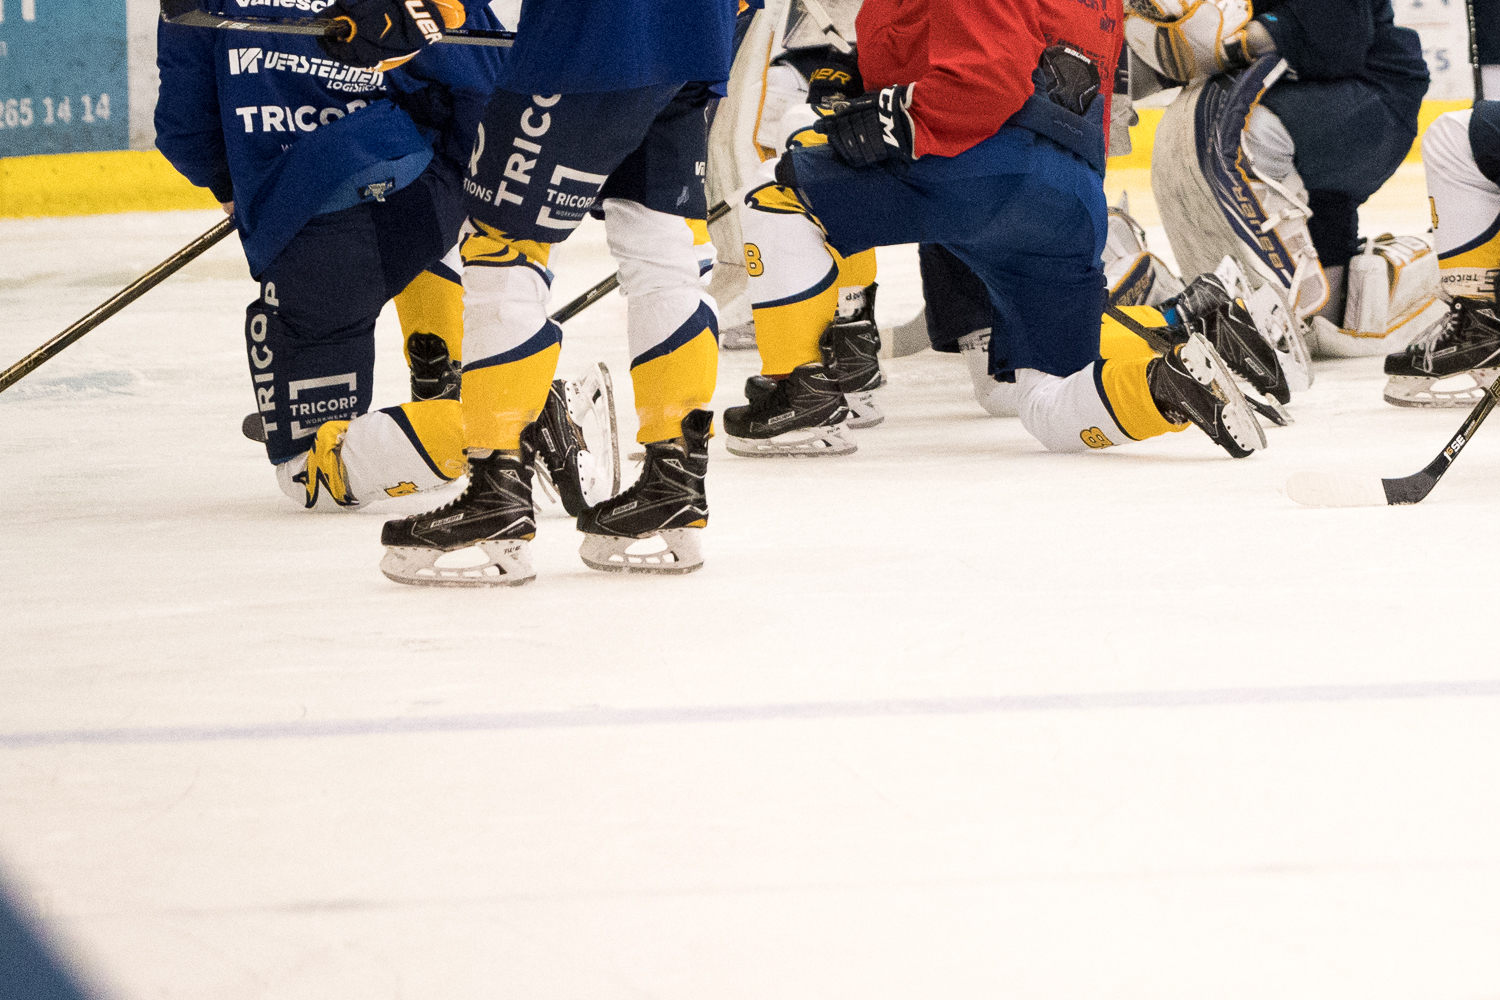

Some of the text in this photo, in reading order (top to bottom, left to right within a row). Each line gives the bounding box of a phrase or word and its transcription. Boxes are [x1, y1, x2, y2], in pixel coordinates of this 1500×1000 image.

[42, 95, 72, 126] 14
[80, 92, 111, 123] 14
[289, 395, 358, 417] TRICORP
